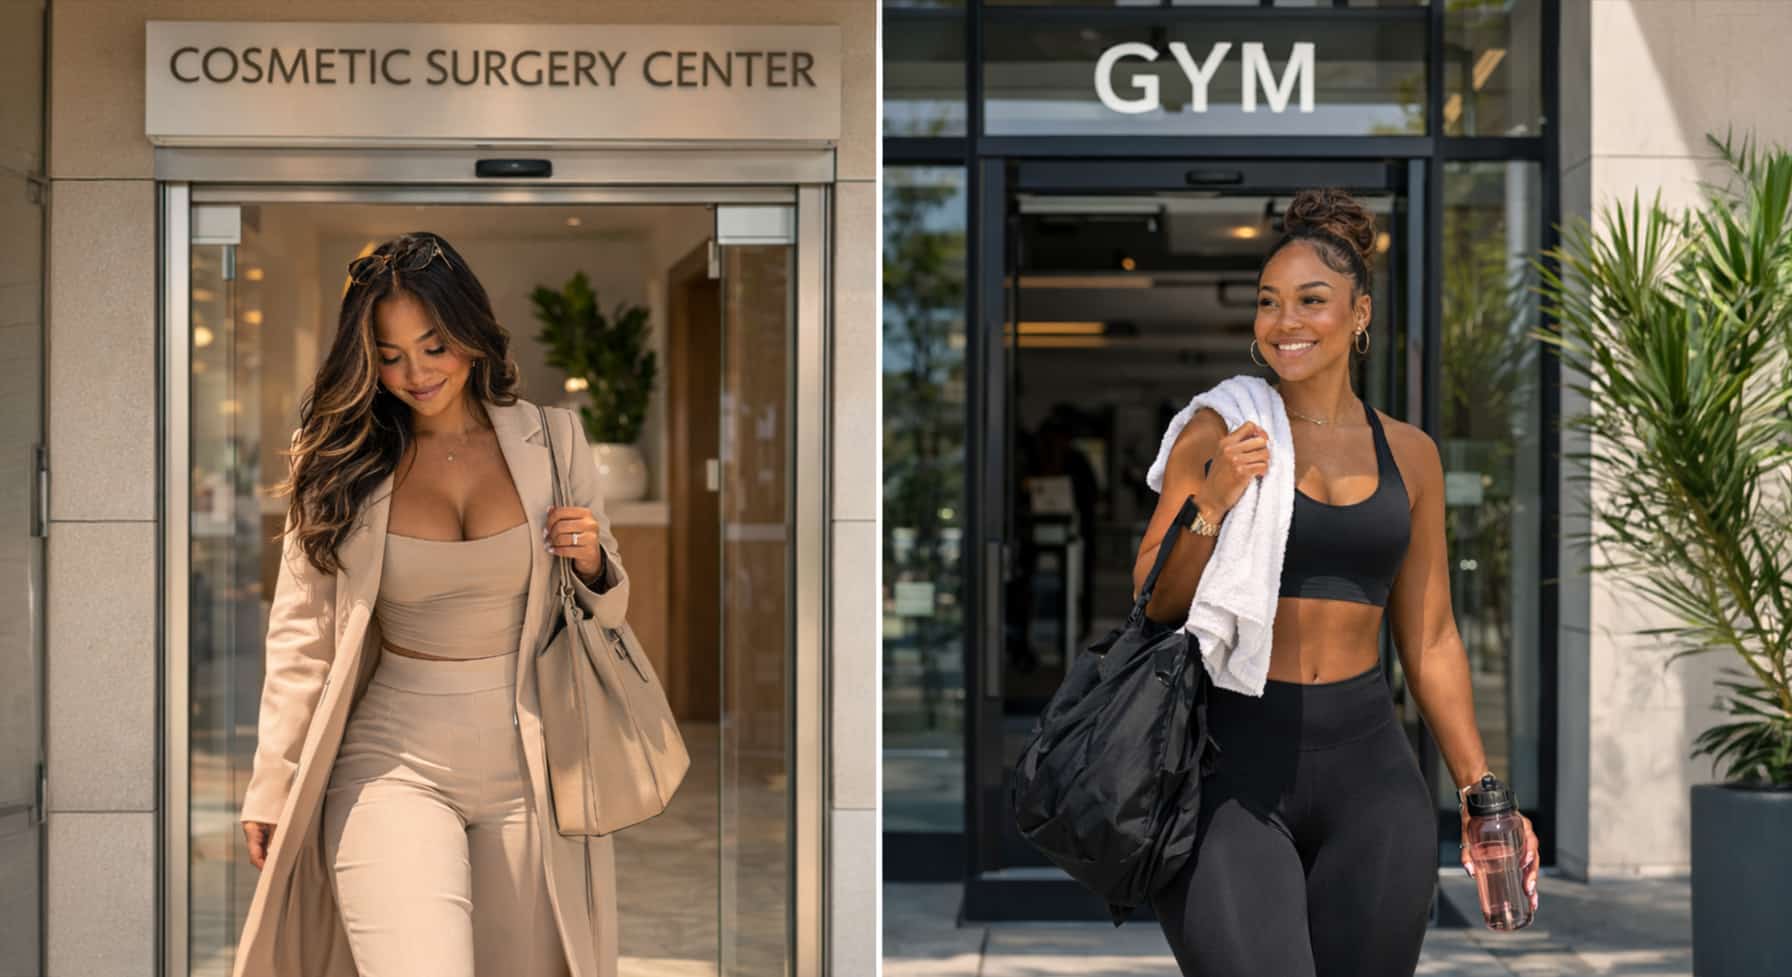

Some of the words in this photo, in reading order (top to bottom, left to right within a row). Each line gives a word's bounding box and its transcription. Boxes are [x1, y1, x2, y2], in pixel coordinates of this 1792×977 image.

[169, 46, 412, 86] COSMETIC
[426, 48, 628, 88] SURGERY
[643, 50, 817, 89] CENTER
[1094, 41, 1317, 114] GYM
